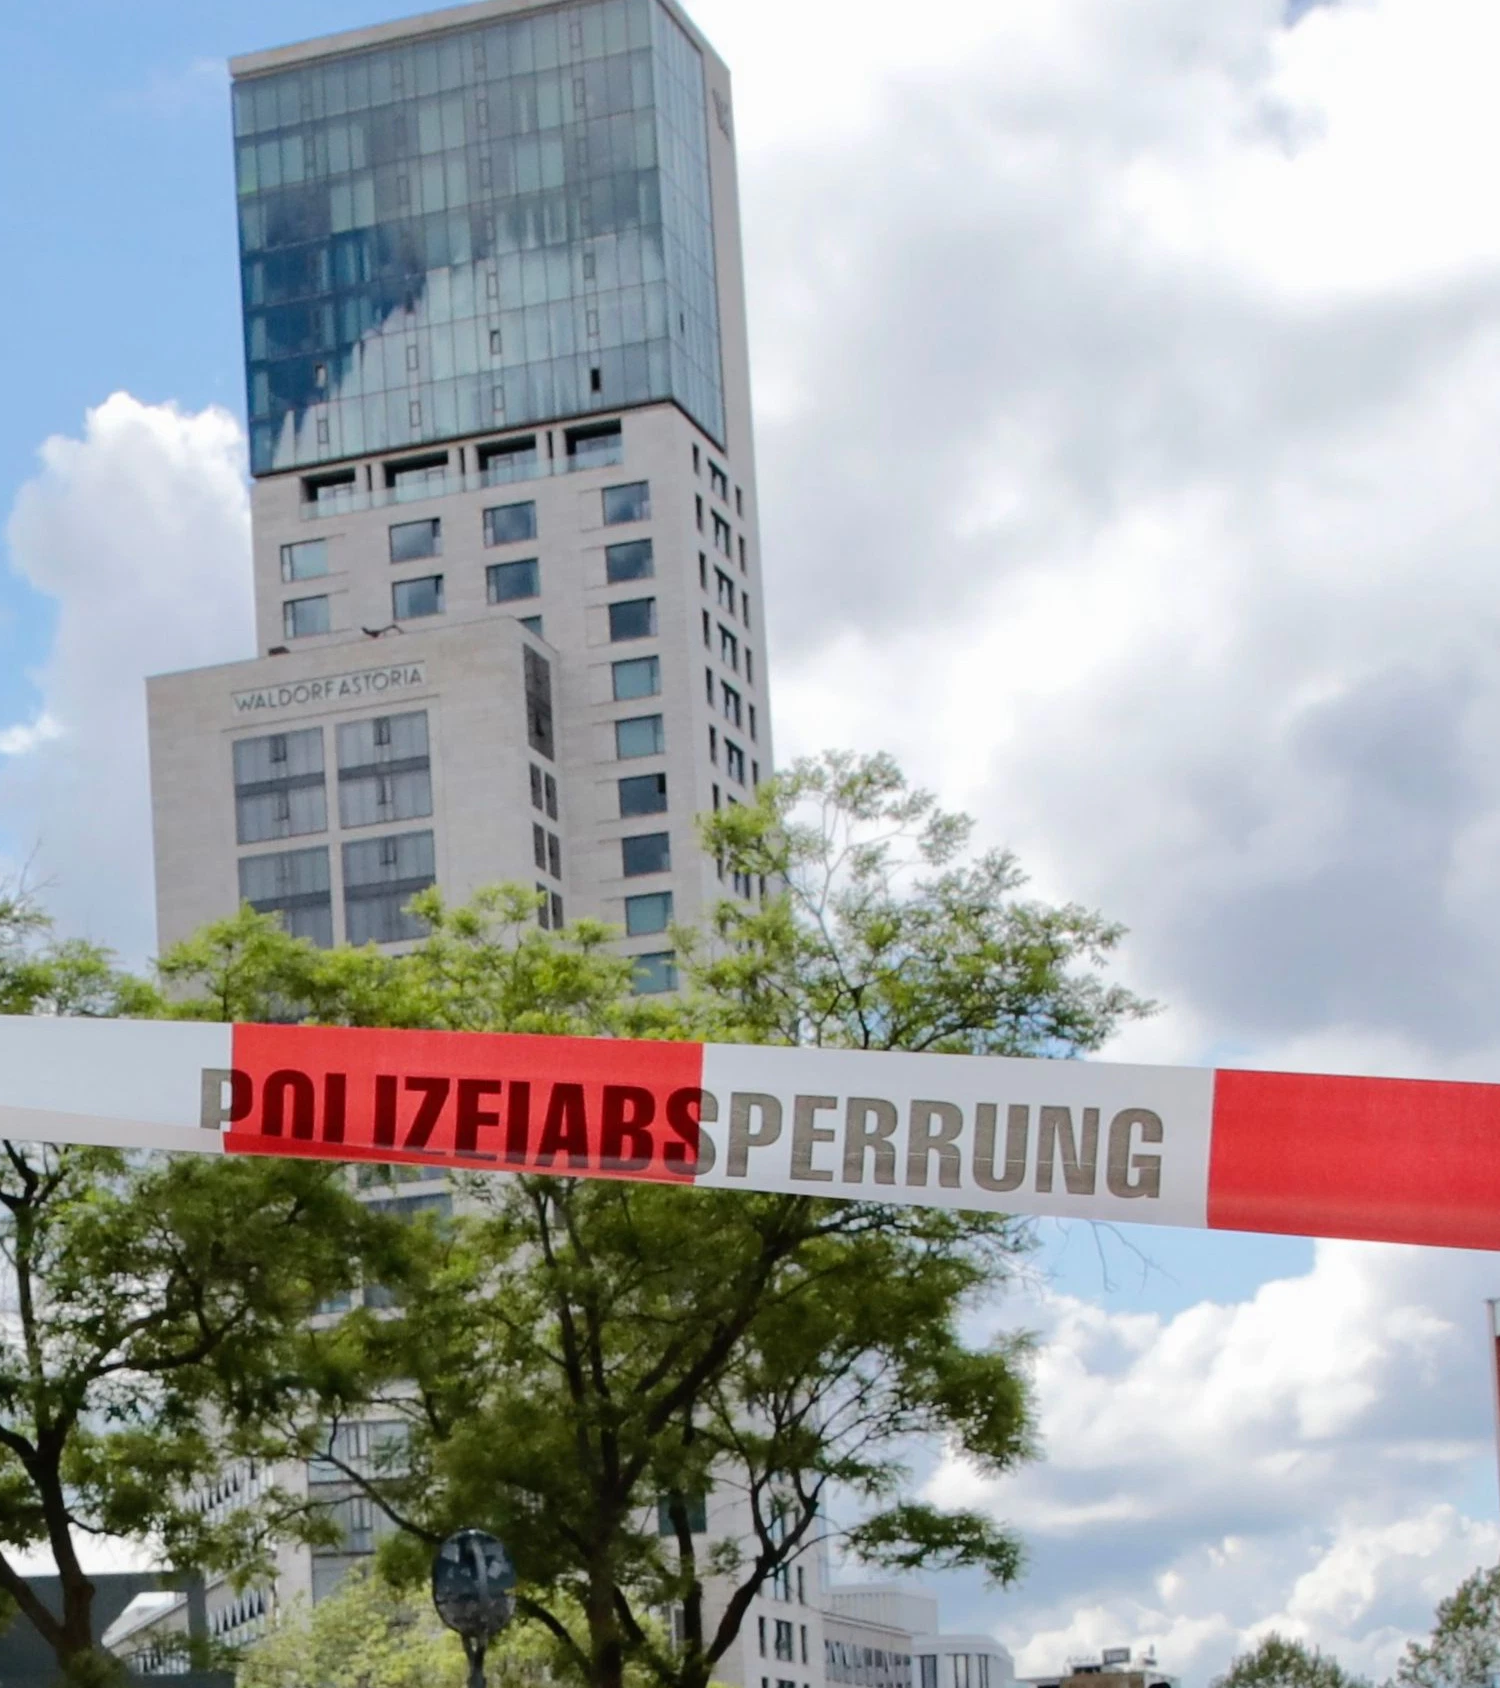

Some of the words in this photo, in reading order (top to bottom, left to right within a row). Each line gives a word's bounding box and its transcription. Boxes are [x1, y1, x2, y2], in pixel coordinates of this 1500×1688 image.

[235, 681, 335, 712] WALDORF
[338, 668, 423, 697] ASTORIA
[201, 1067, 1164, 1199] POLIZEIABSPERRUNG
